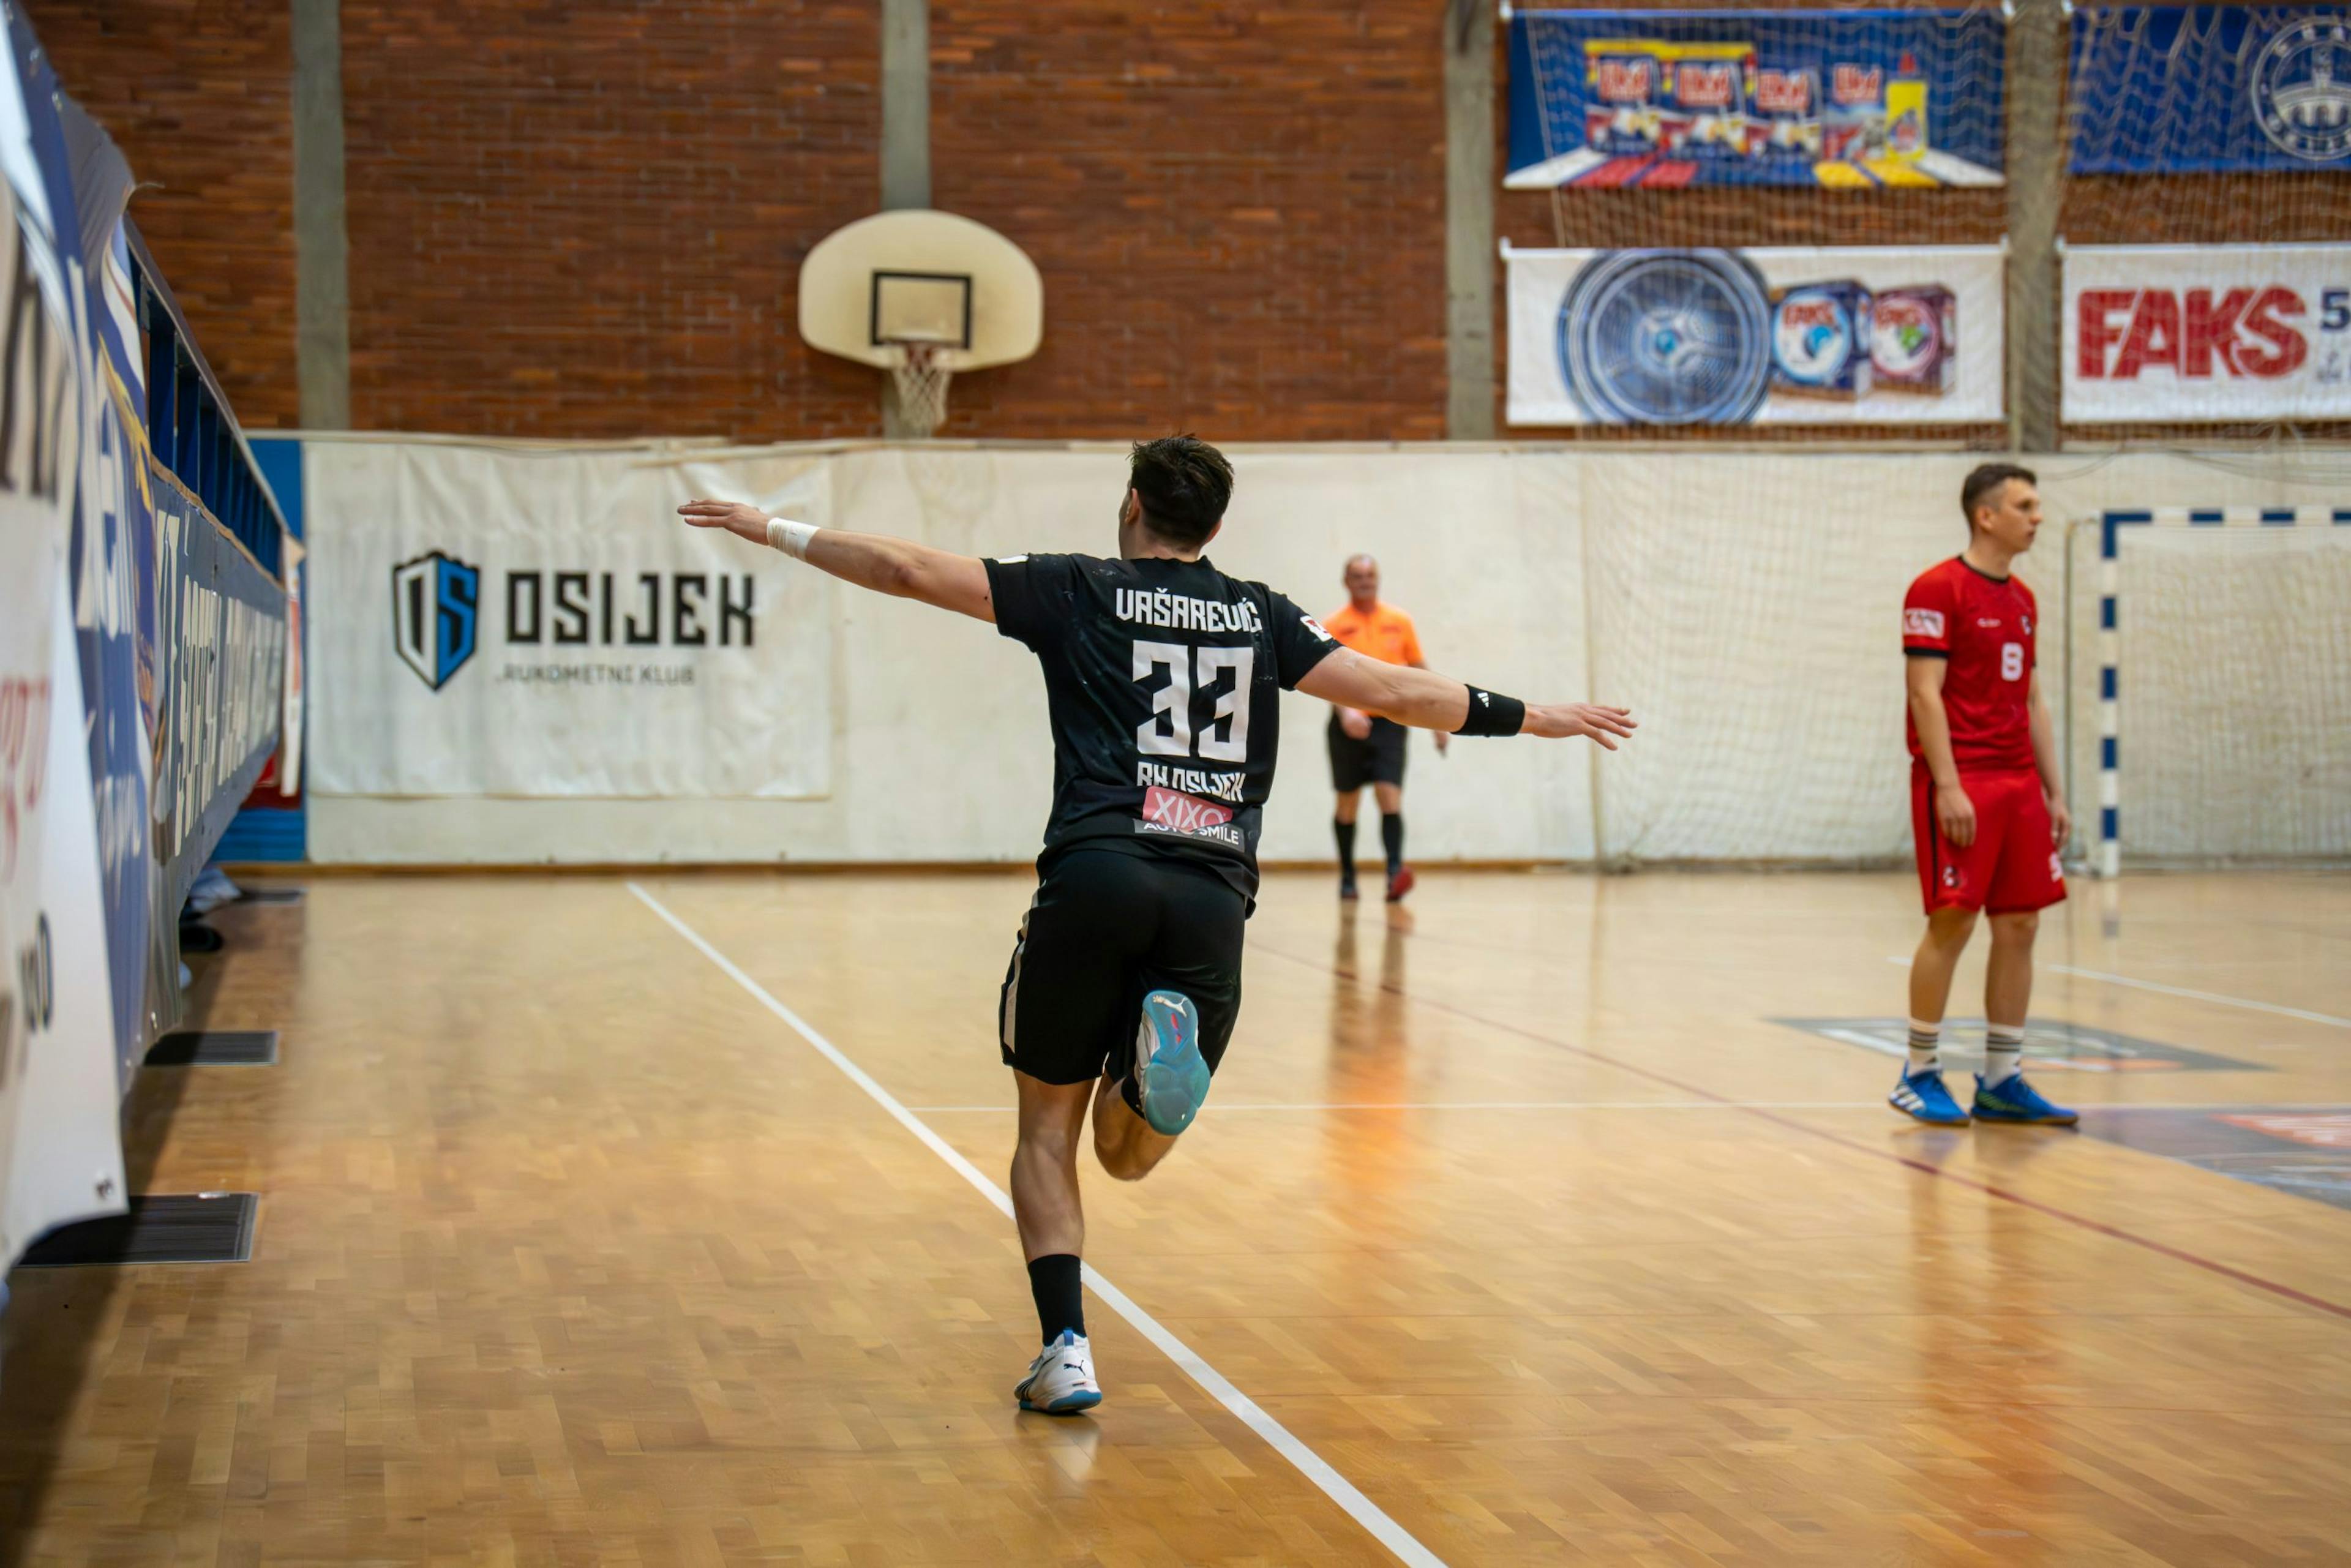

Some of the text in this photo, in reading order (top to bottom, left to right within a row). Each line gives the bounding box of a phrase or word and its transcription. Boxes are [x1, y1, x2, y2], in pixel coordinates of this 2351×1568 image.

[2076, 285, 2308, 381] FAKS
[506, 571, 754, 646] OSIJEK
[1116, 587, 1263, 634] VAŠAREVIĆ
[1133, 639, 1254, 763] 33
[1150, 792, 1225, 830] XIXO
